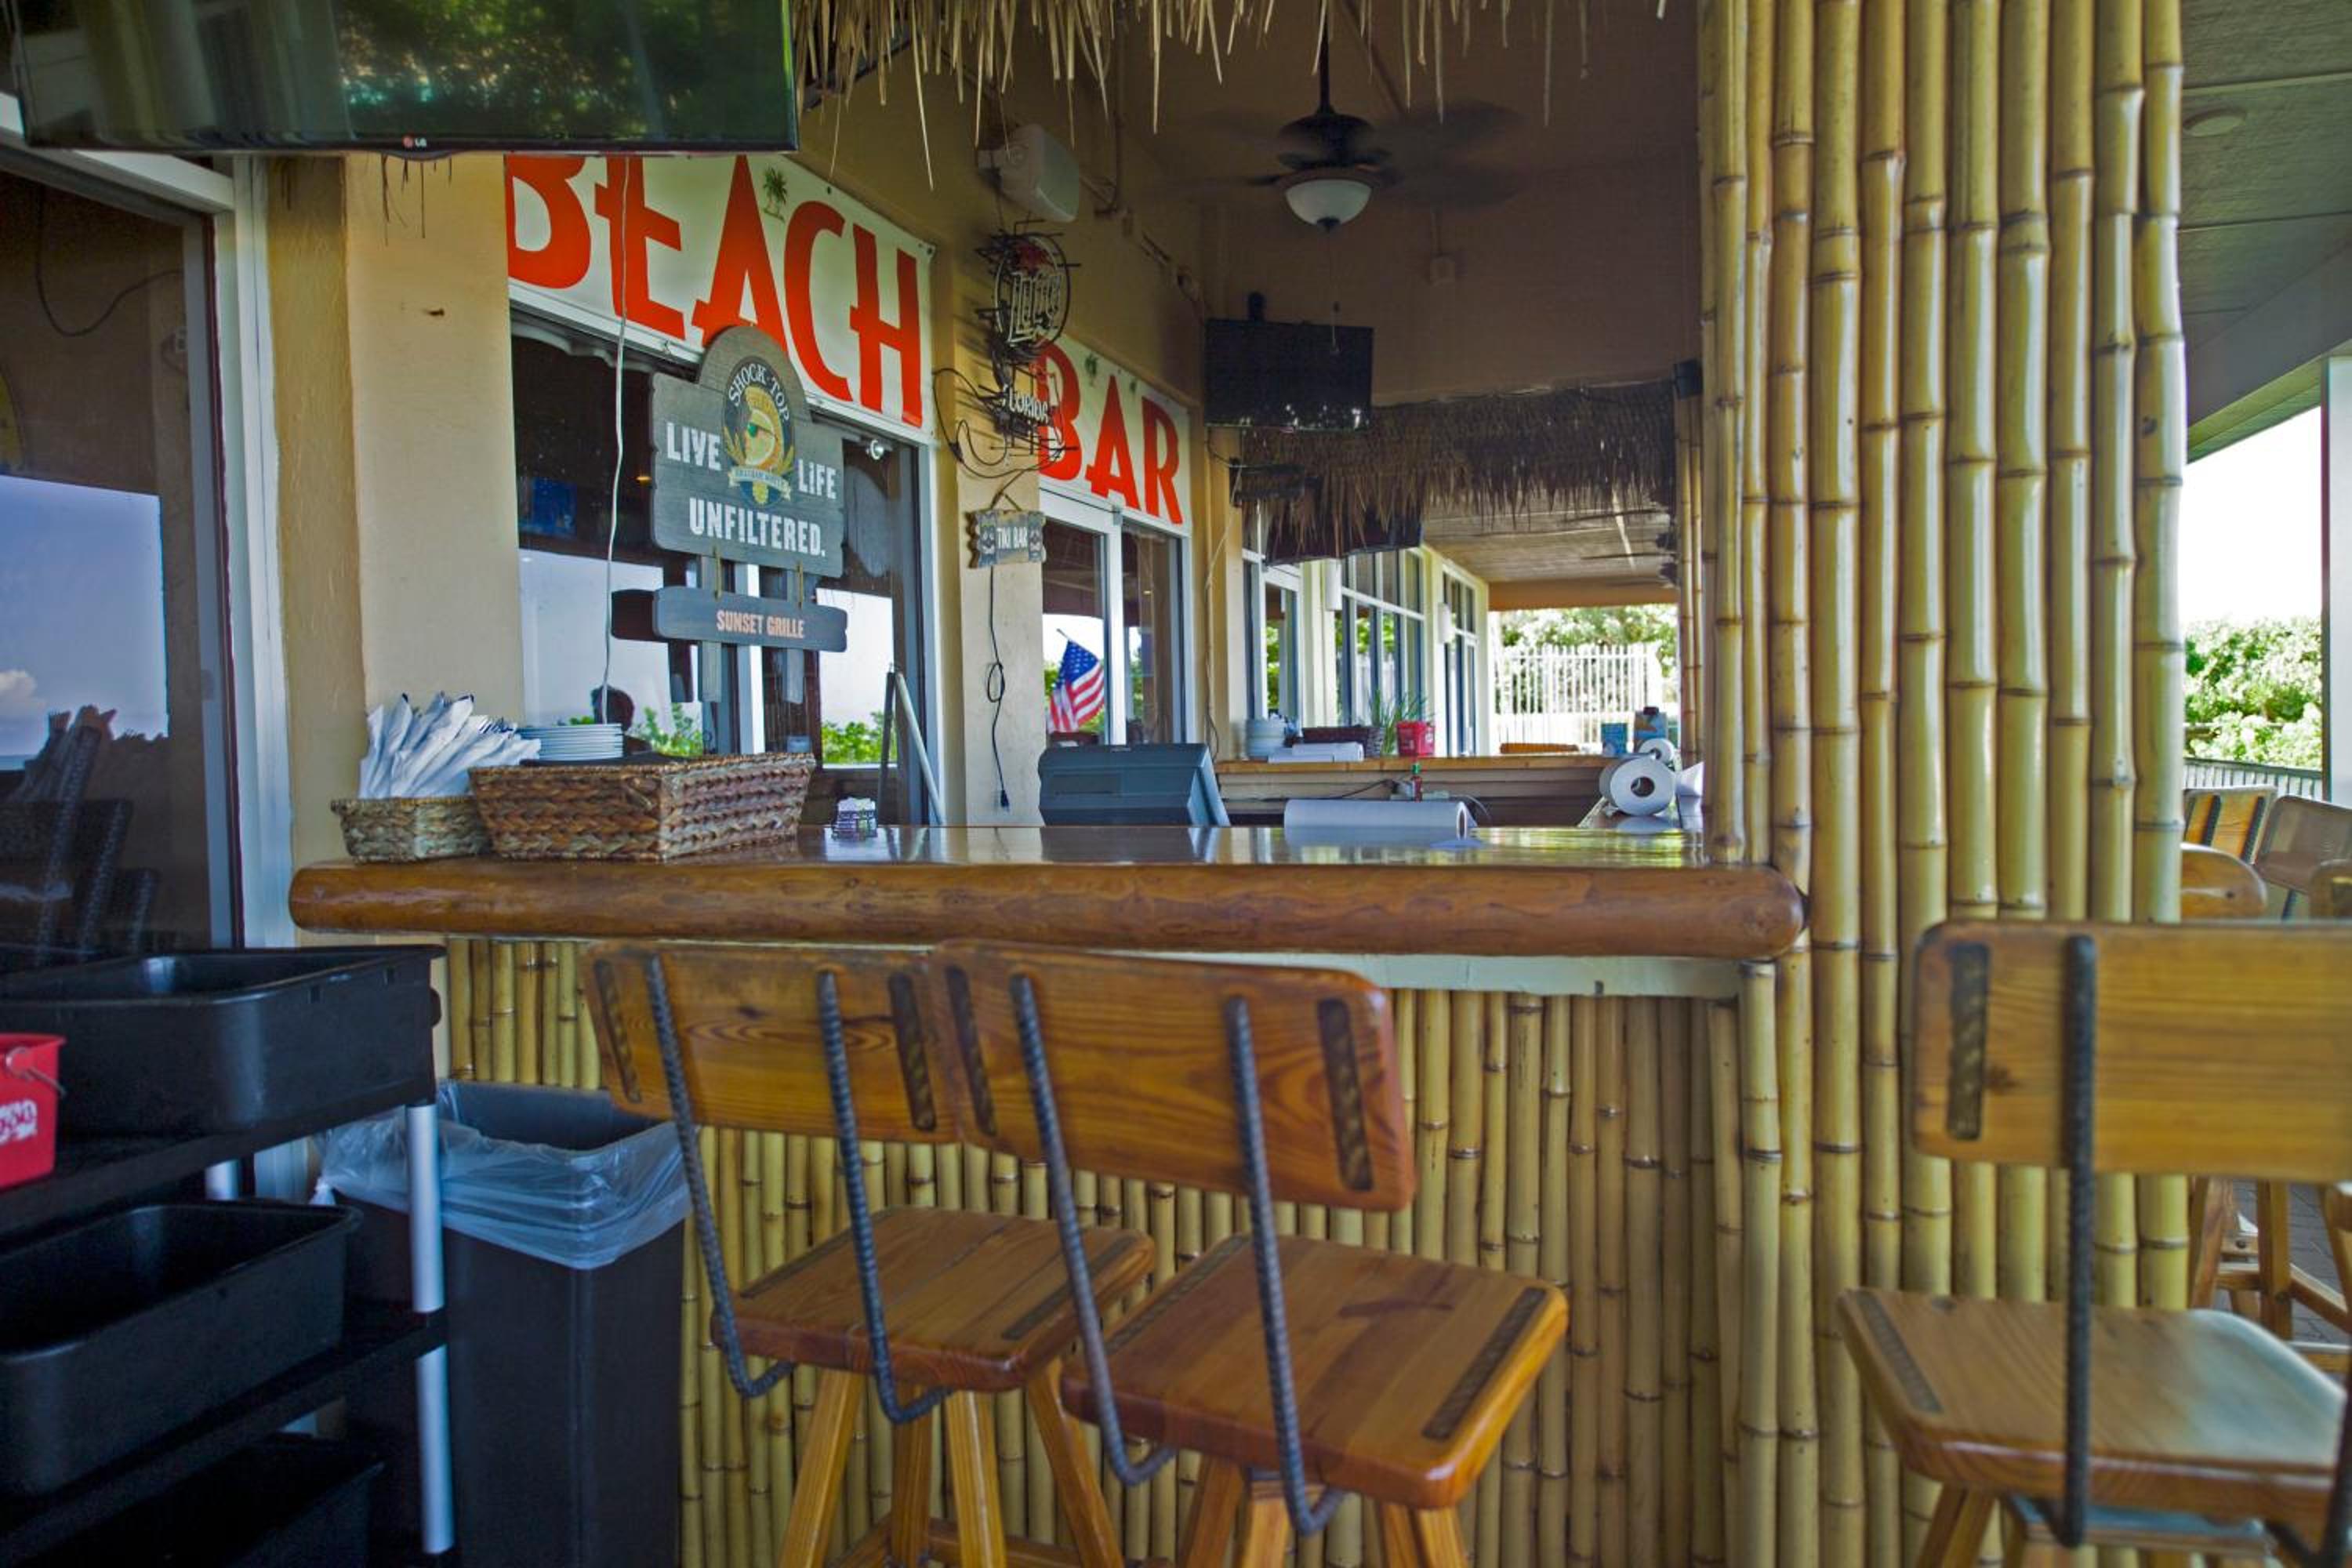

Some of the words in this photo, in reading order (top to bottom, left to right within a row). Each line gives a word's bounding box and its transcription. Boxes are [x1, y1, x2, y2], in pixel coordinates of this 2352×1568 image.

[504, 156, 922, 426] BEACH
[728, 363, 767, 408] SHOCK
[769, 376, 790, 422] TOP
[666, 422, 722, 471] LIVE
[1036, 339, 1183, 524] BAR
[688, 497, 826, 557] UNFILTERED.
[1013, 526, 1029, 549] BAR
[716, 609, 765, 635] SUNSET
[766, 615, 805, 639] GRILLE
